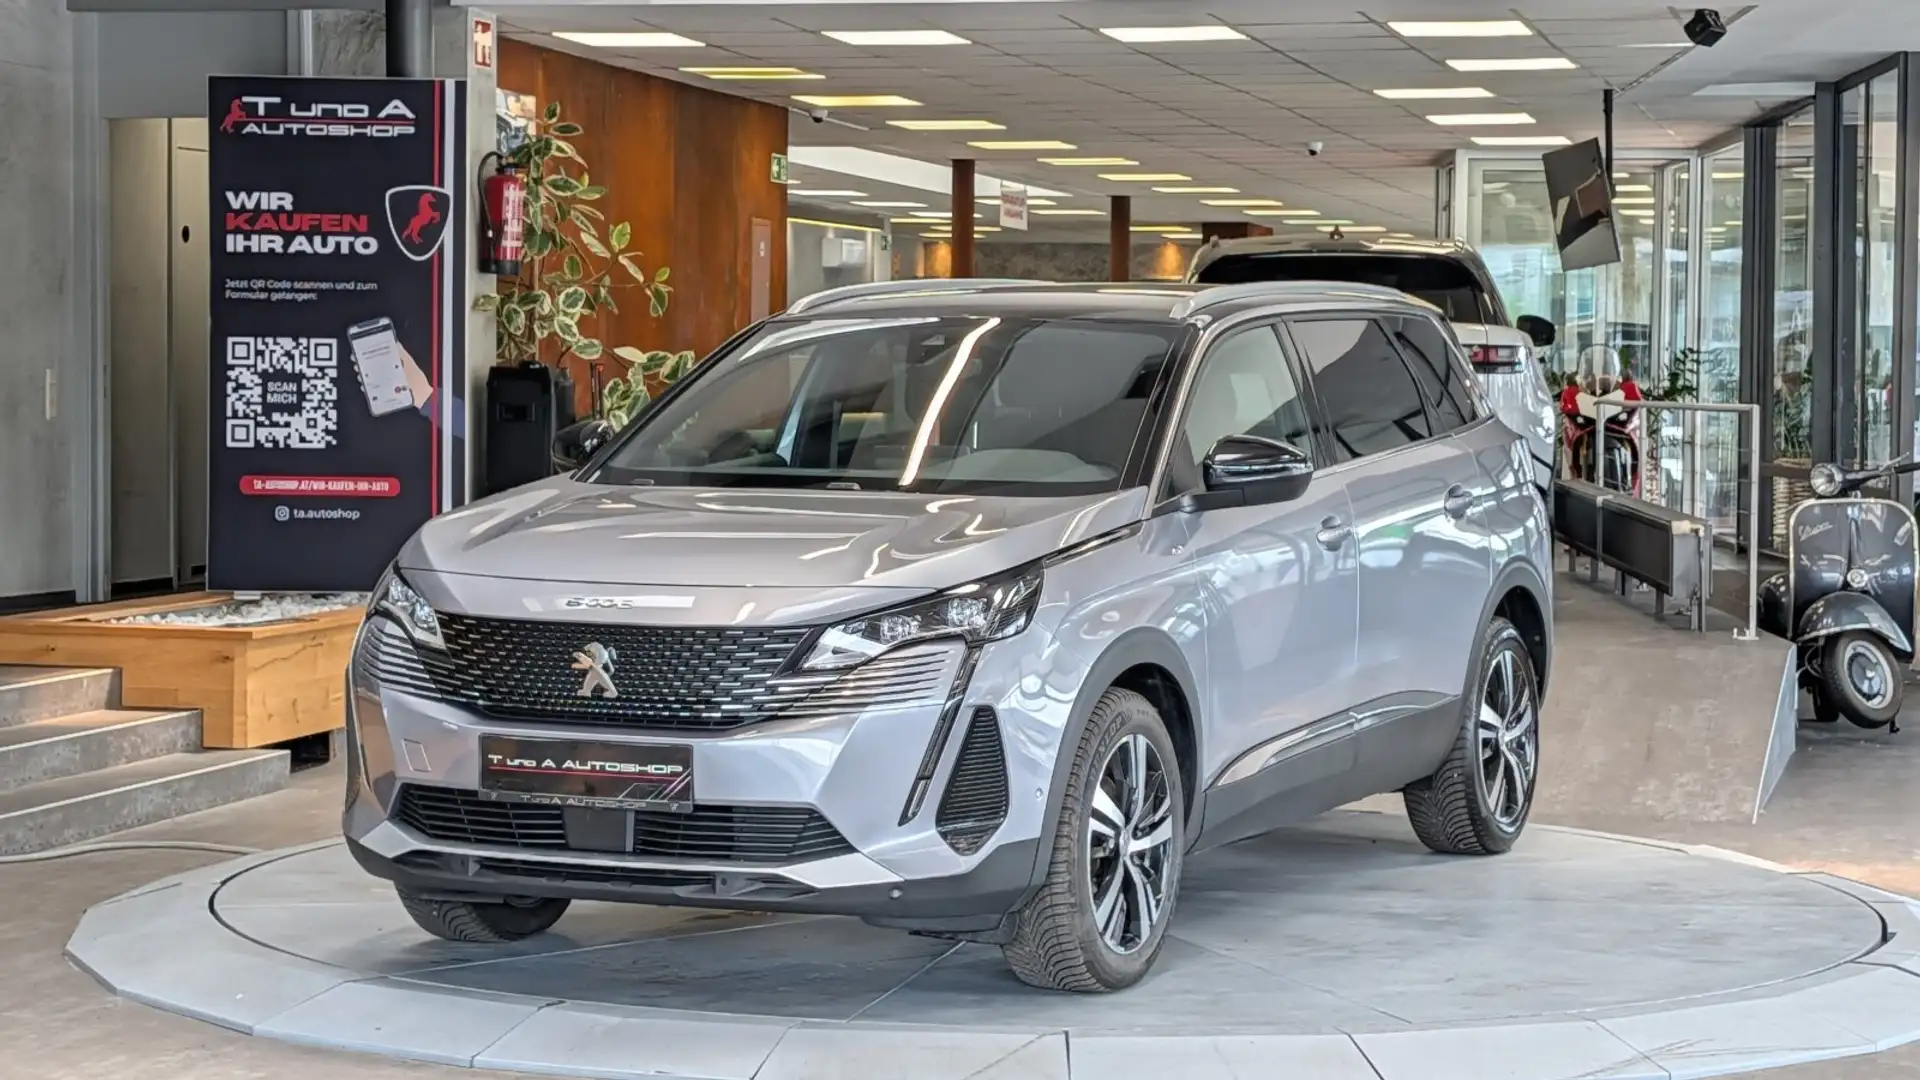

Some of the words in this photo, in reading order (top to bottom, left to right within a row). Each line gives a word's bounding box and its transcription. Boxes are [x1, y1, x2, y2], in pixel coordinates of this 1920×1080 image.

[241, 96, 281, 116] T
[377, 99, 416, 119] A
[241, 123, 416, 137] AUTOSHOP
[225, 191, 294, 211] WIR
[225, 213, 369, 232] KAUFEN
[226, 234, 285, 253] IHR
[287, 235, 379, 255] AUTO
[225, 279, 249, 289] Jetzt
[250, 279, 265, 290] QR
[267, 280, 292, 289] Code
[293, 281, 334, 290] scannen
[335, 281, 354, 290] und
[356, 282, 378, 290] zum
[225, 290, 269, 299] Formular
[267, 381, 297, 392] SCAN
[266, 393, 297, 404] MICH
[293, 508, 361, 521] ta.autoshop
[488, 755, 502, 764] T
[541, 759, 556, 769] A
[562, 759, 683, 774] AUTOSHOP
[566, 796, 647, 809] AUTOSHOP
